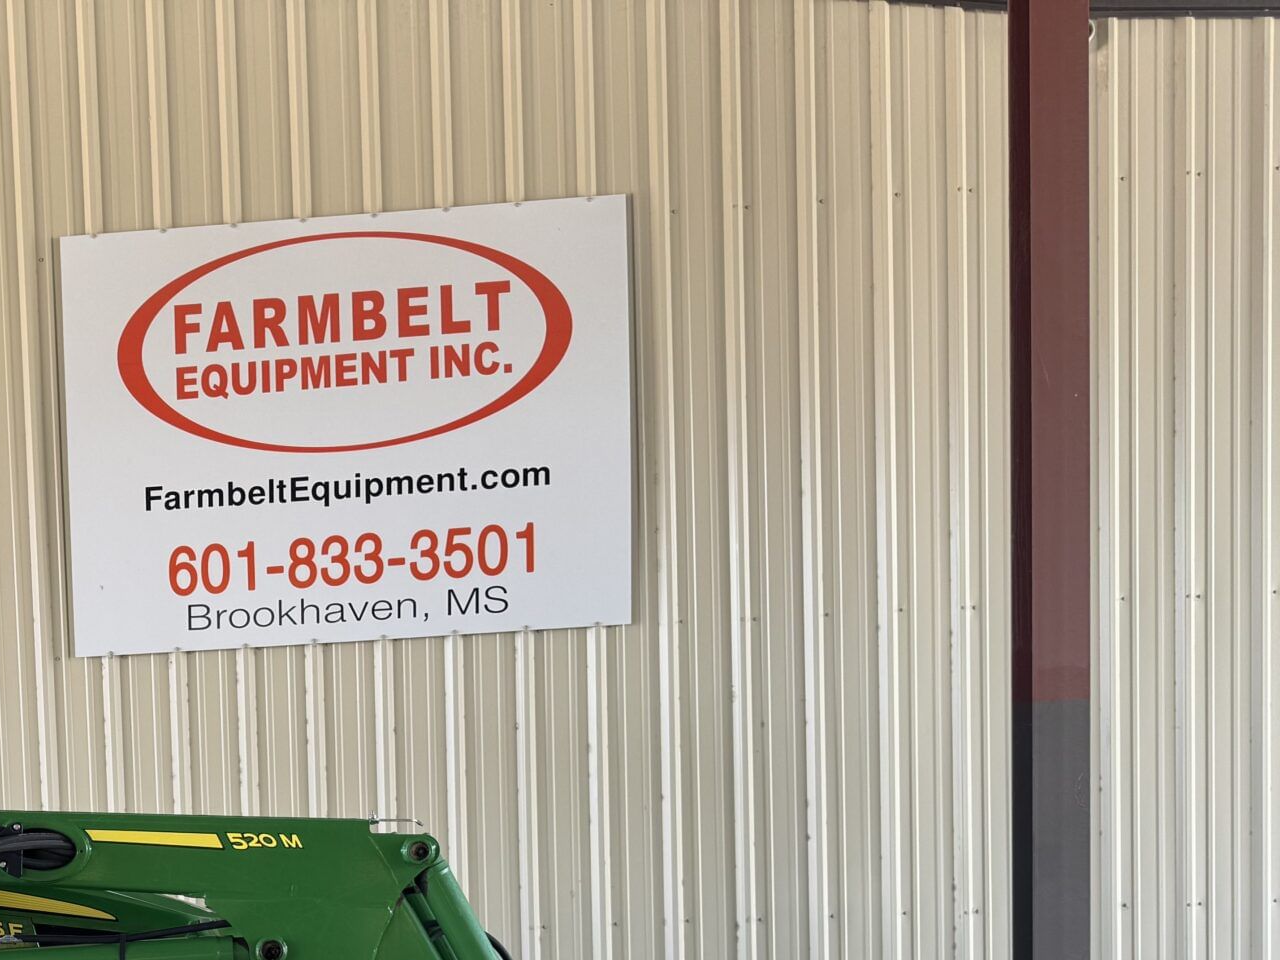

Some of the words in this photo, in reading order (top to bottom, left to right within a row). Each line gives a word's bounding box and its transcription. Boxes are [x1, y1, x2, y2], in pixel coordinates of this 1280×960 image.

[173, 280, 511, 355] FARMBELT
[175, 348, 415, 401] EQUIPMENT
[429, 340, 514, 380] INC.
[144, 465, 552, 512] FarmbeltEquipment.com
[168, 521, 537, 597] 601-833-3501
[186, 595, 430, 632] Brookhaven,
[446, 584, 510, 617] MS
[226, 832, 277, 850] 520
[279, 833, 303, 849] M
